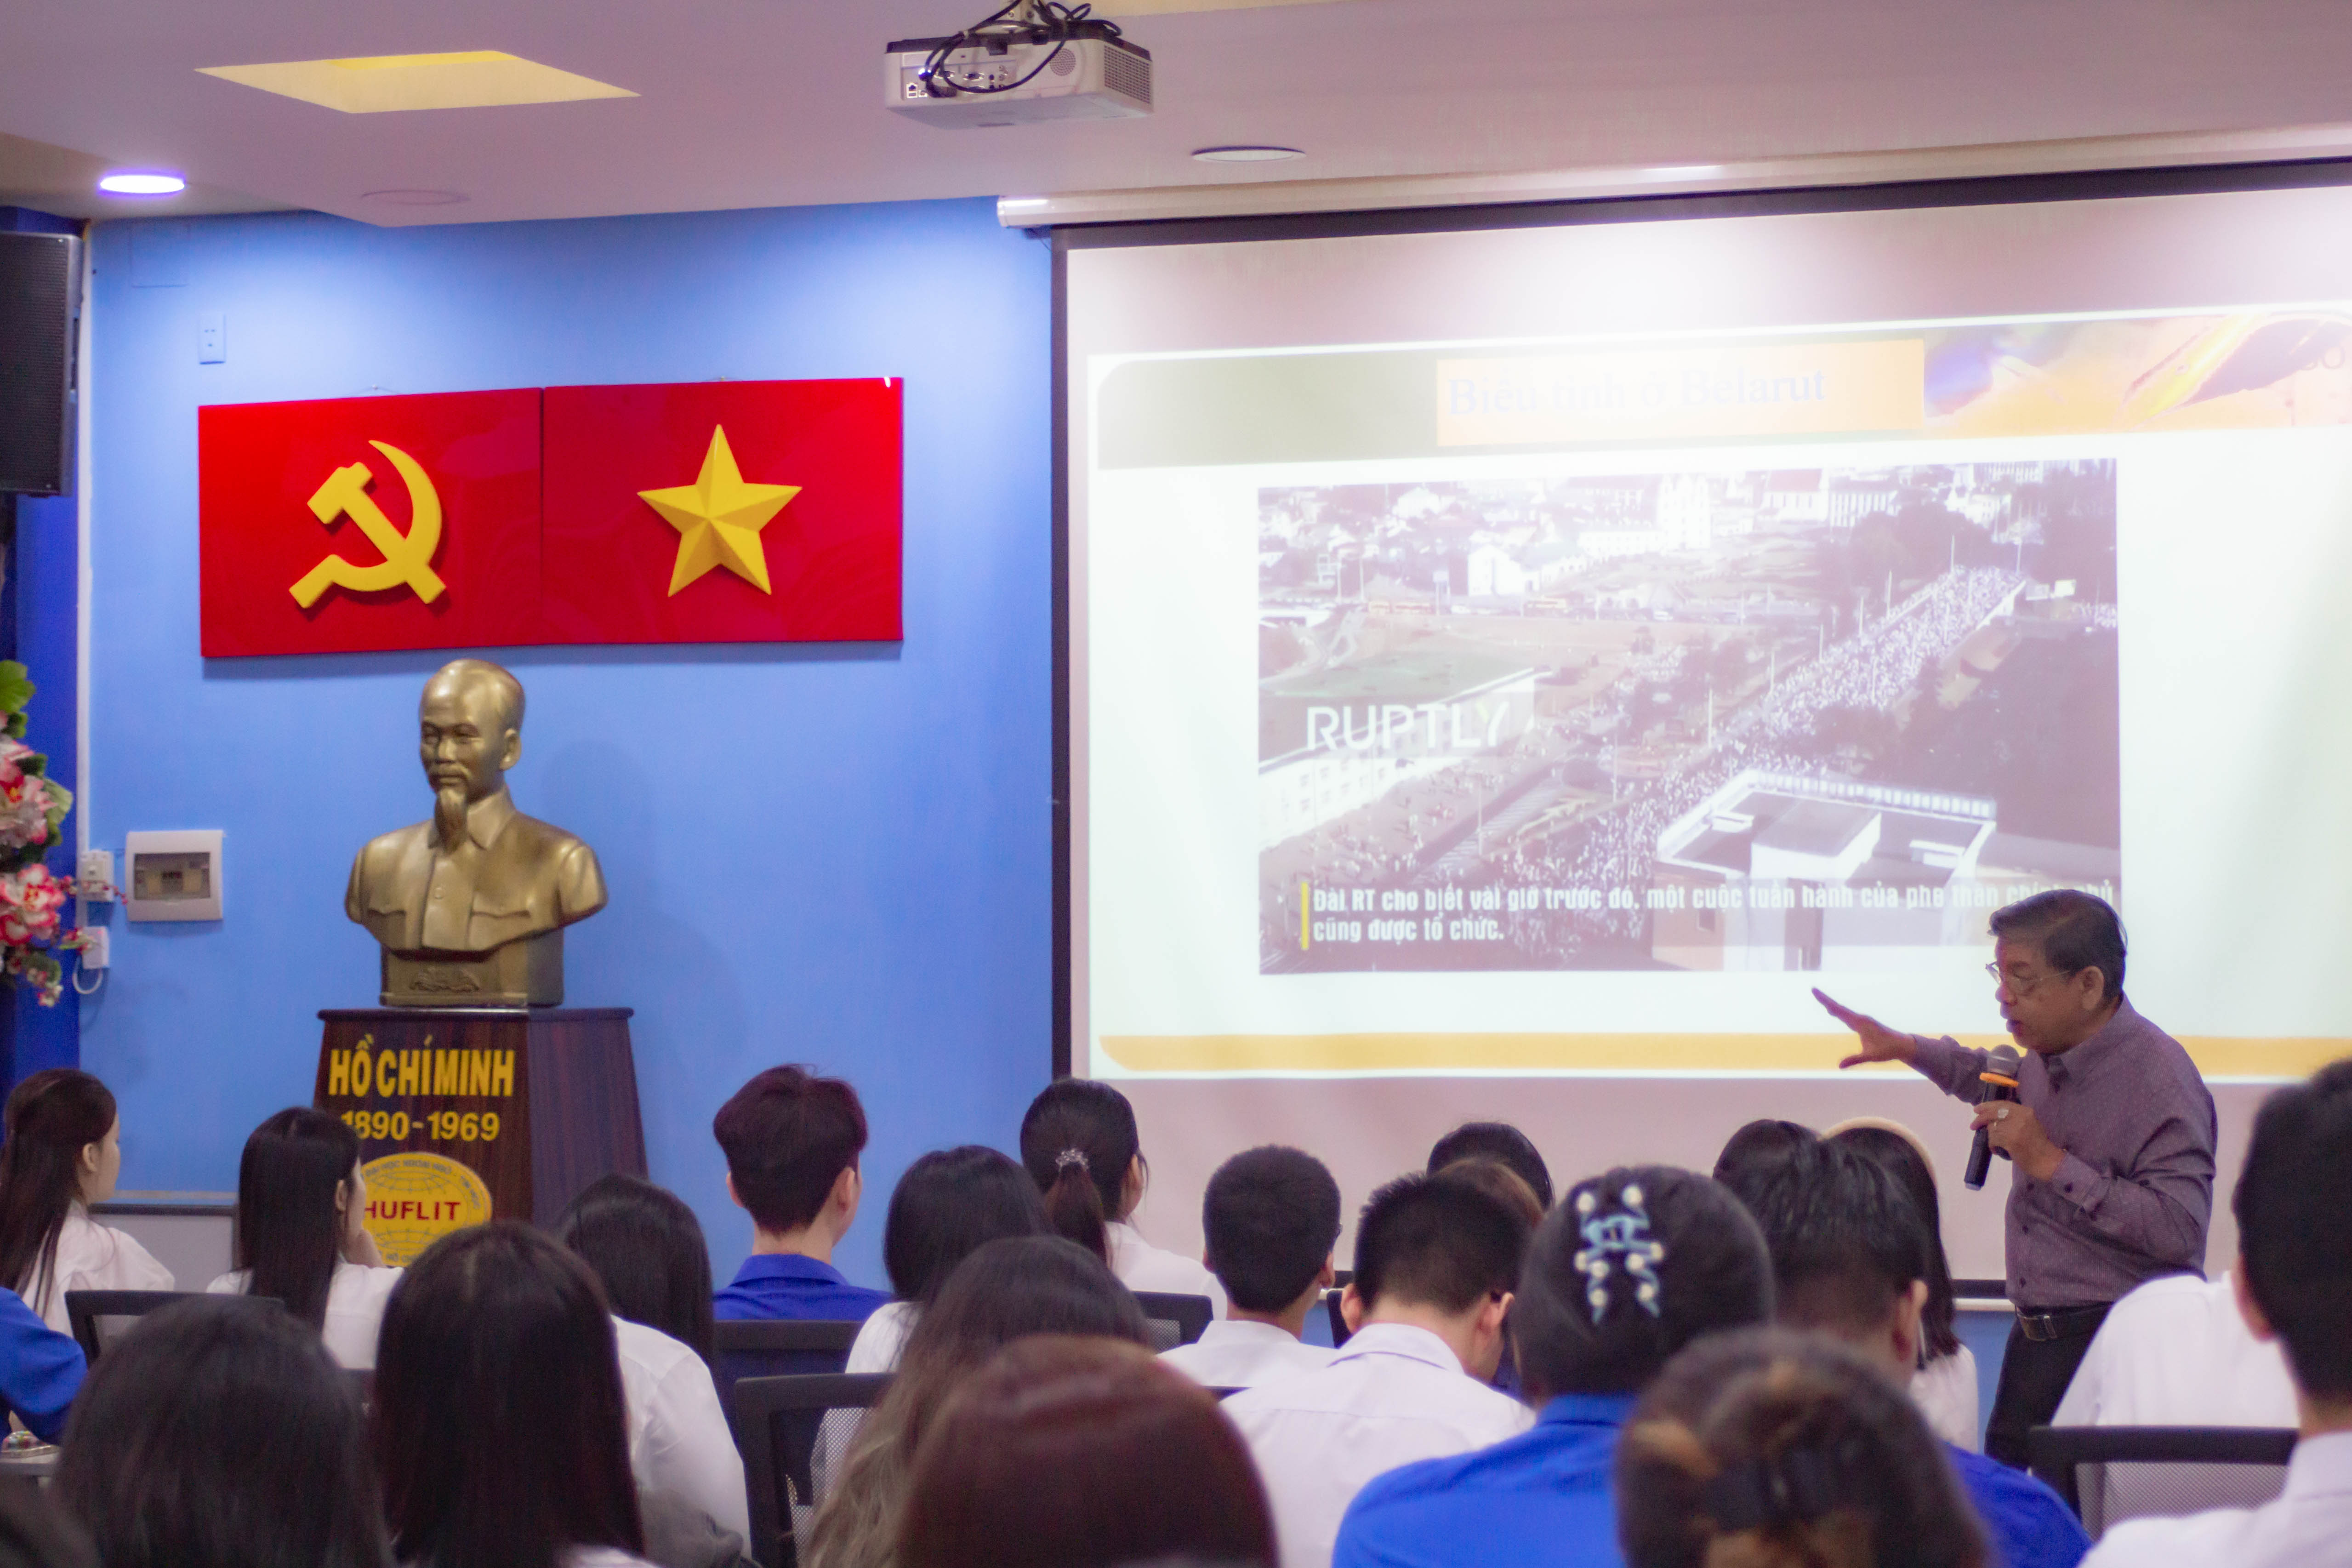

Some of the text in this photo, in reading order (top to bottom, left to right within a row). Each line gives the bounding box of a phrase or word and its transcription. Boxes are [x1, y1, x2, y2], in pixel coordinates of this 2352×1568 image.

[1680, 365, 1828, 405] Belarut
[1306, 701, 1509, 750] RUPTLY
[1352, 888, 1376, 911] RT
[1382, 888, 1418, 911] cho
[1424, 883, 1464, 911] biết
[1469, 885, 1501, 911] vài
[1543, 885, 1602, 910] trước
[1647, 884, 1685, 913] một
[1692, 884, 1742, 912] cuộc
[1802, 883, 1853, 908] hành
[1862, 880, 1899, 908] của
[1906, 884, 1944, 910] phe
[1313, 917, 1361, 942] cũng
[1368, 918, 1417, 945] được
[328, 1033, 515, 1098] HỒ CHÍ MINH
[364, 1201, 461, 1221] HUFLIT
